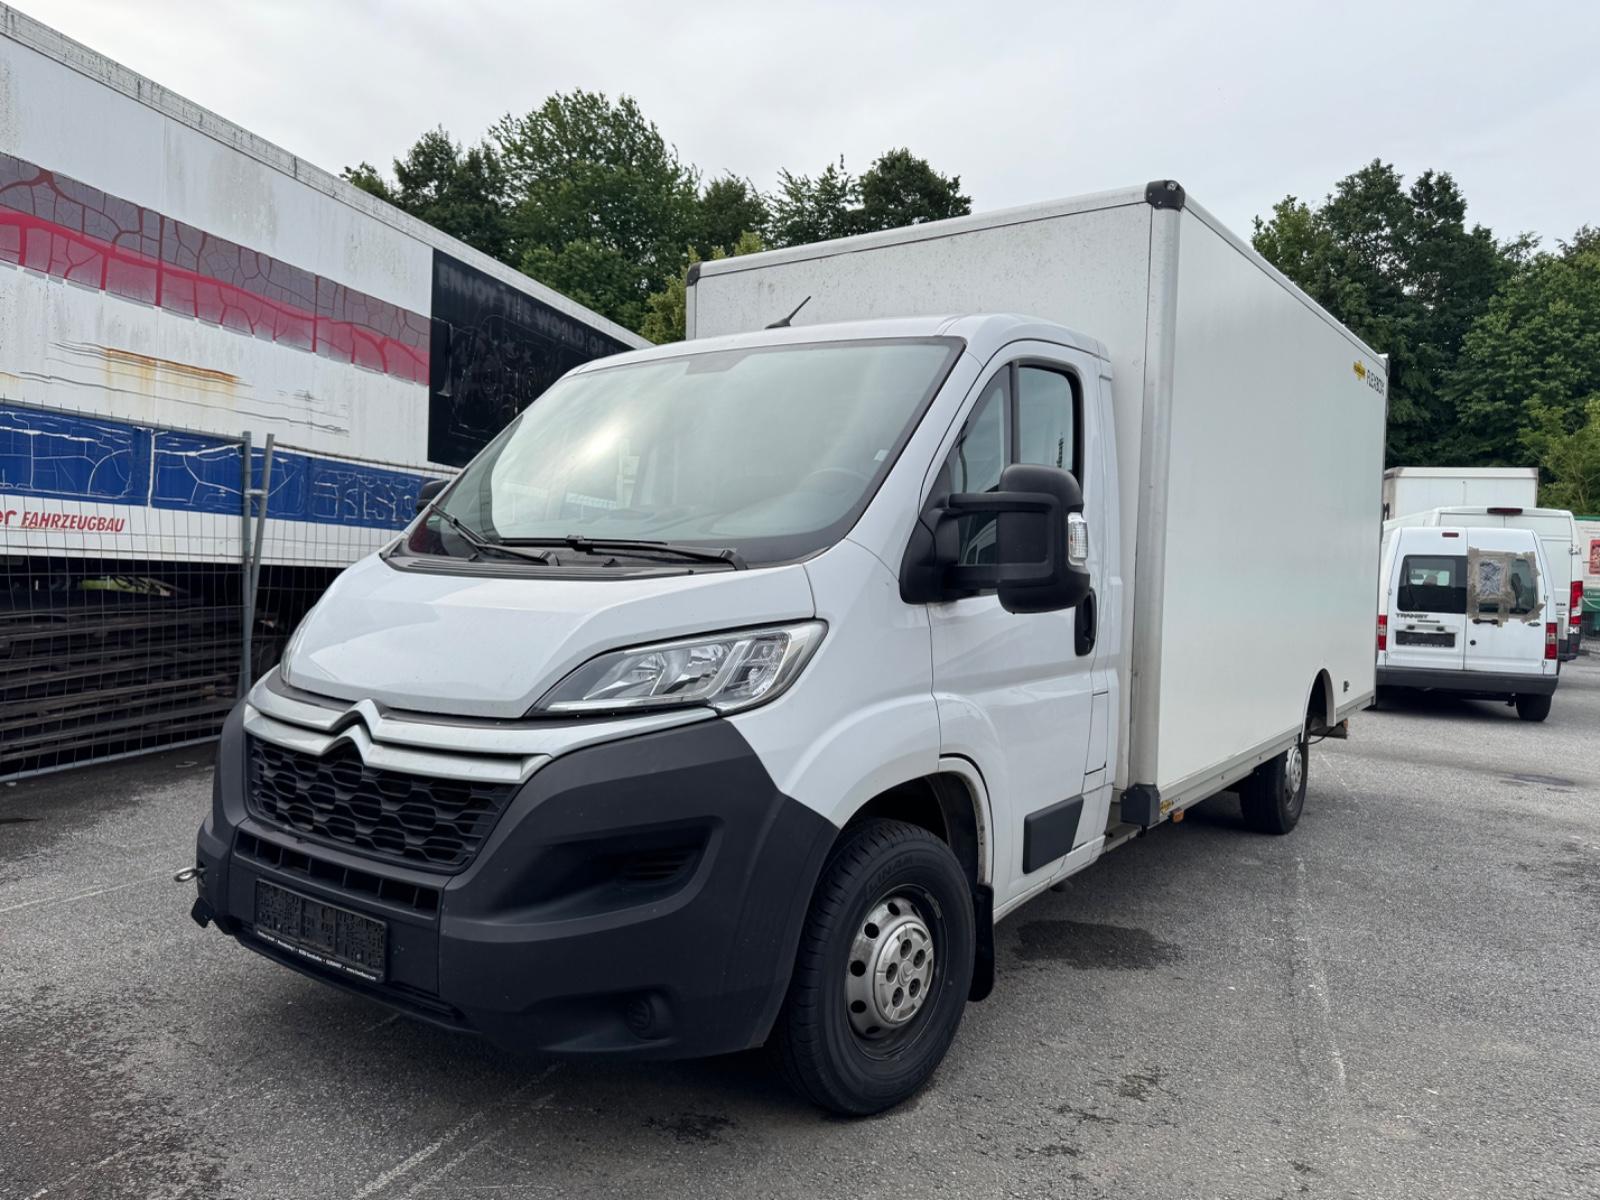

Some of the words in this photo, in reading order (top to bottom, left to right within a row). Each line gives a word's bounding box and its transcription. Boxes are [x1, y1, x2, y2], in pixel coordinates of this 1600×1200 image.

[438, 262, 498, 307] ENJOY
[500, 285, 532, 323] THE
[535, 307, 585, 346] WORLD
[21, 511, 125, 532] FAHRZEUGBAU
